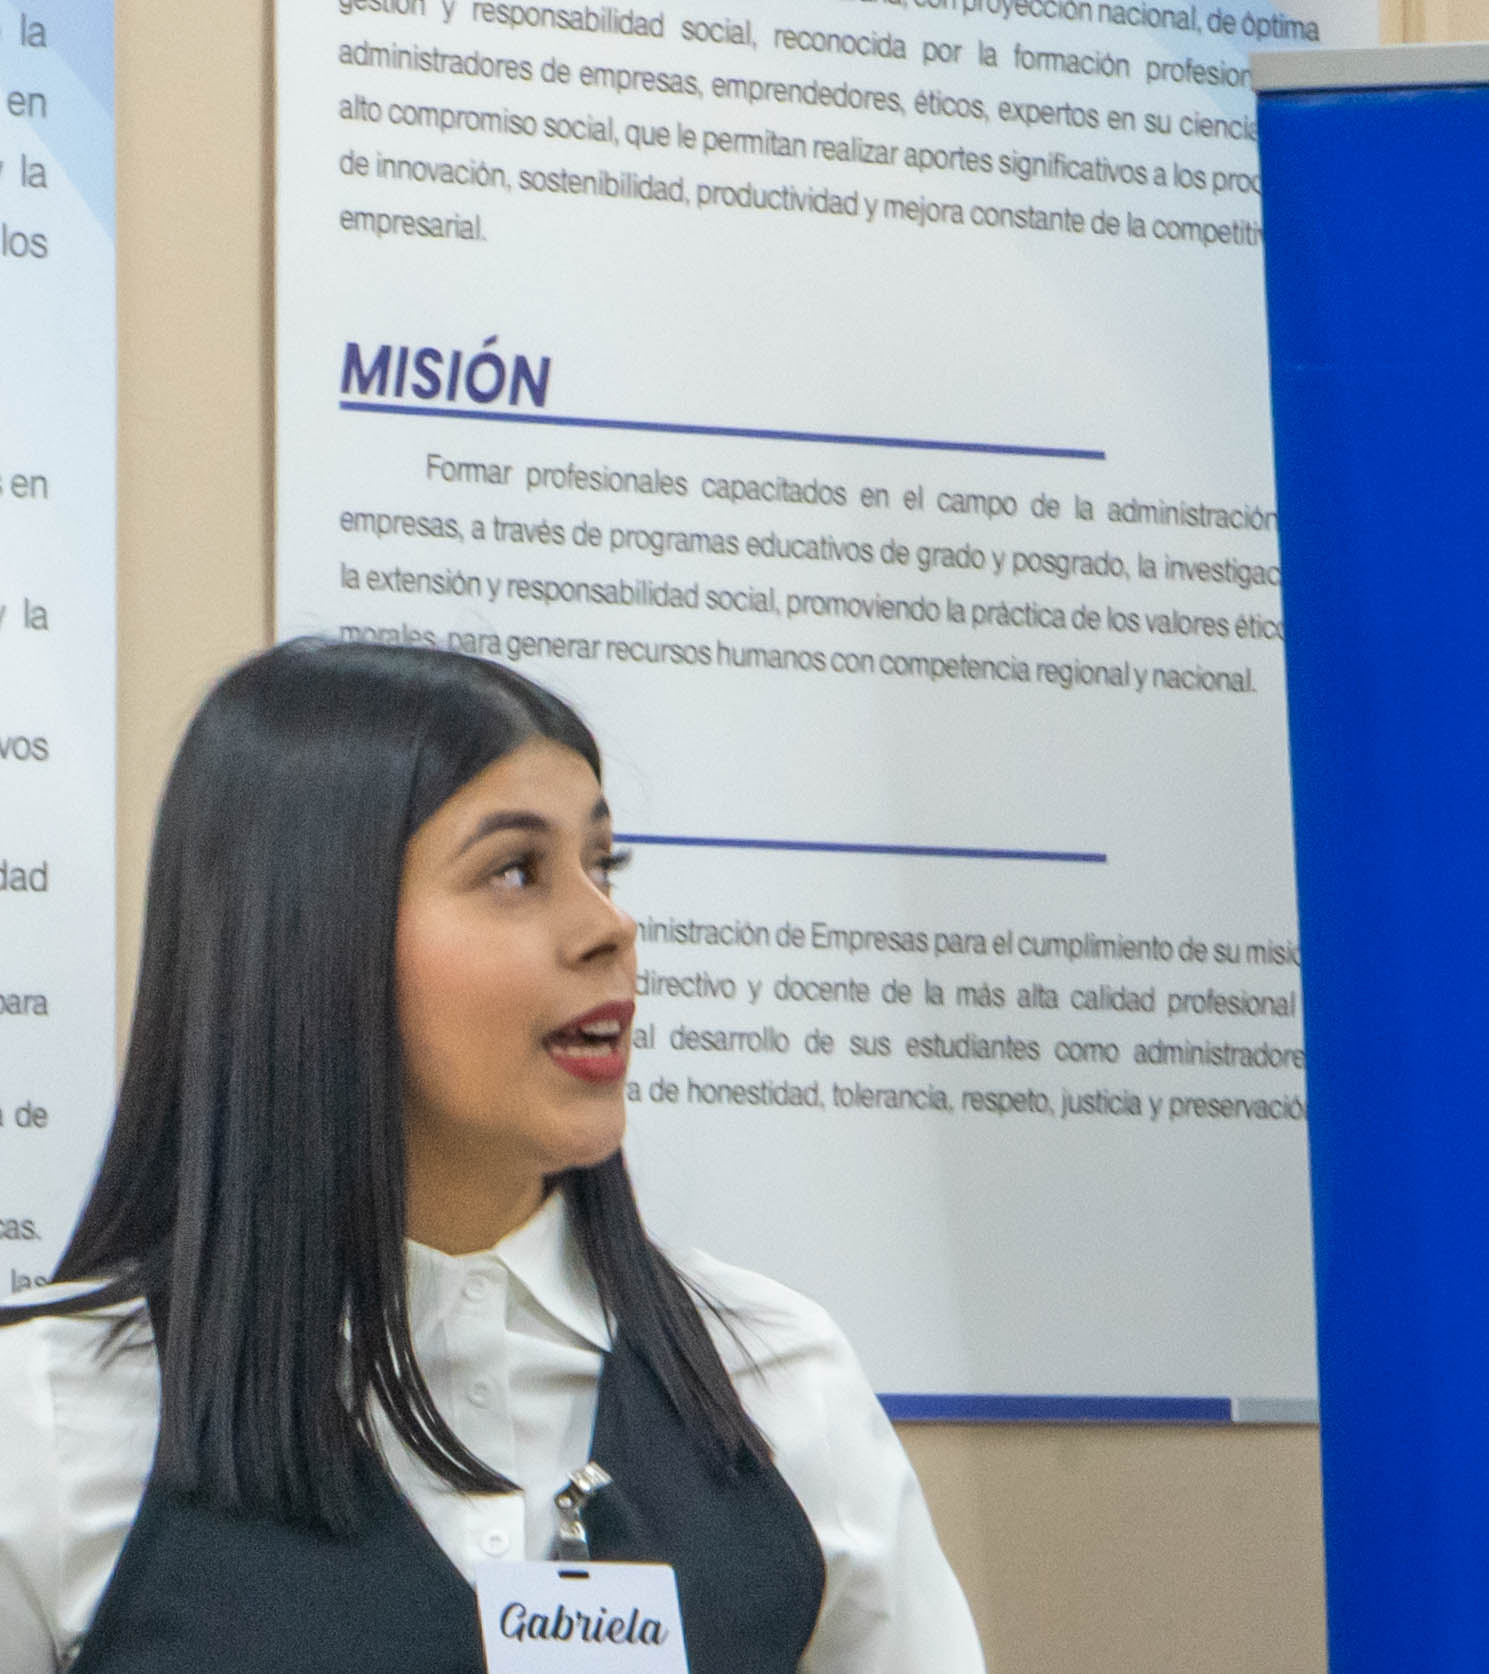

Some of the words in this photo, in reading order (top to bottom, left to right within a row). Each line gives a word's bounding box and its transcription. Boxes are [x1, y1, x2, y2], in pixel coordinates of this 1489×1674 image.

[5, 89, 48, 120] en
[1, 221, 49, 260] los
[338, 209, 487, 241] empresarial.
[341, 335, 552, 408] MISIÓN
[426, 453, 513, 485] Formar
[526, 462, 689, 497] profesionales
[701, 477, 848, 507] capacitados
[860, 487, 889, 509] en
[903, 485, 924, 511] el
[936, 492, 1018, 520] campo
[1030, 492, 1061, 519] de
[1075, 495, 1094, 521] la
[339, 510, 465, 543] empresas,
[471, 519, 486, 541] a
[492, 515, 566, 546] través
[571, 520, 603, 548] de
[609, 527, 740, 558] programas
[745, 531, 875, 564] educativos
[879, 538, 911, 566] de
[915, 542, 987, 573] grado
[991, 550, 1006, 577] y
[1012, 550, 1131, 581] posgrado,
[1137, 551, 1158, 580] la
[23, 596, 50, 631] la
[773, 973, 871, 1005] docente
[880, 977, 913, 1006] de
[924, 977, 945, 1007] la
[955, 981, 1007, 1009] más
[1016, 981, 1060, 1011] alta
[1069, 983, 1156, 1014] calidad
[1167, 987, 1297, 1018] profesional
[499, 1601, 669, 1646] Gabriela
